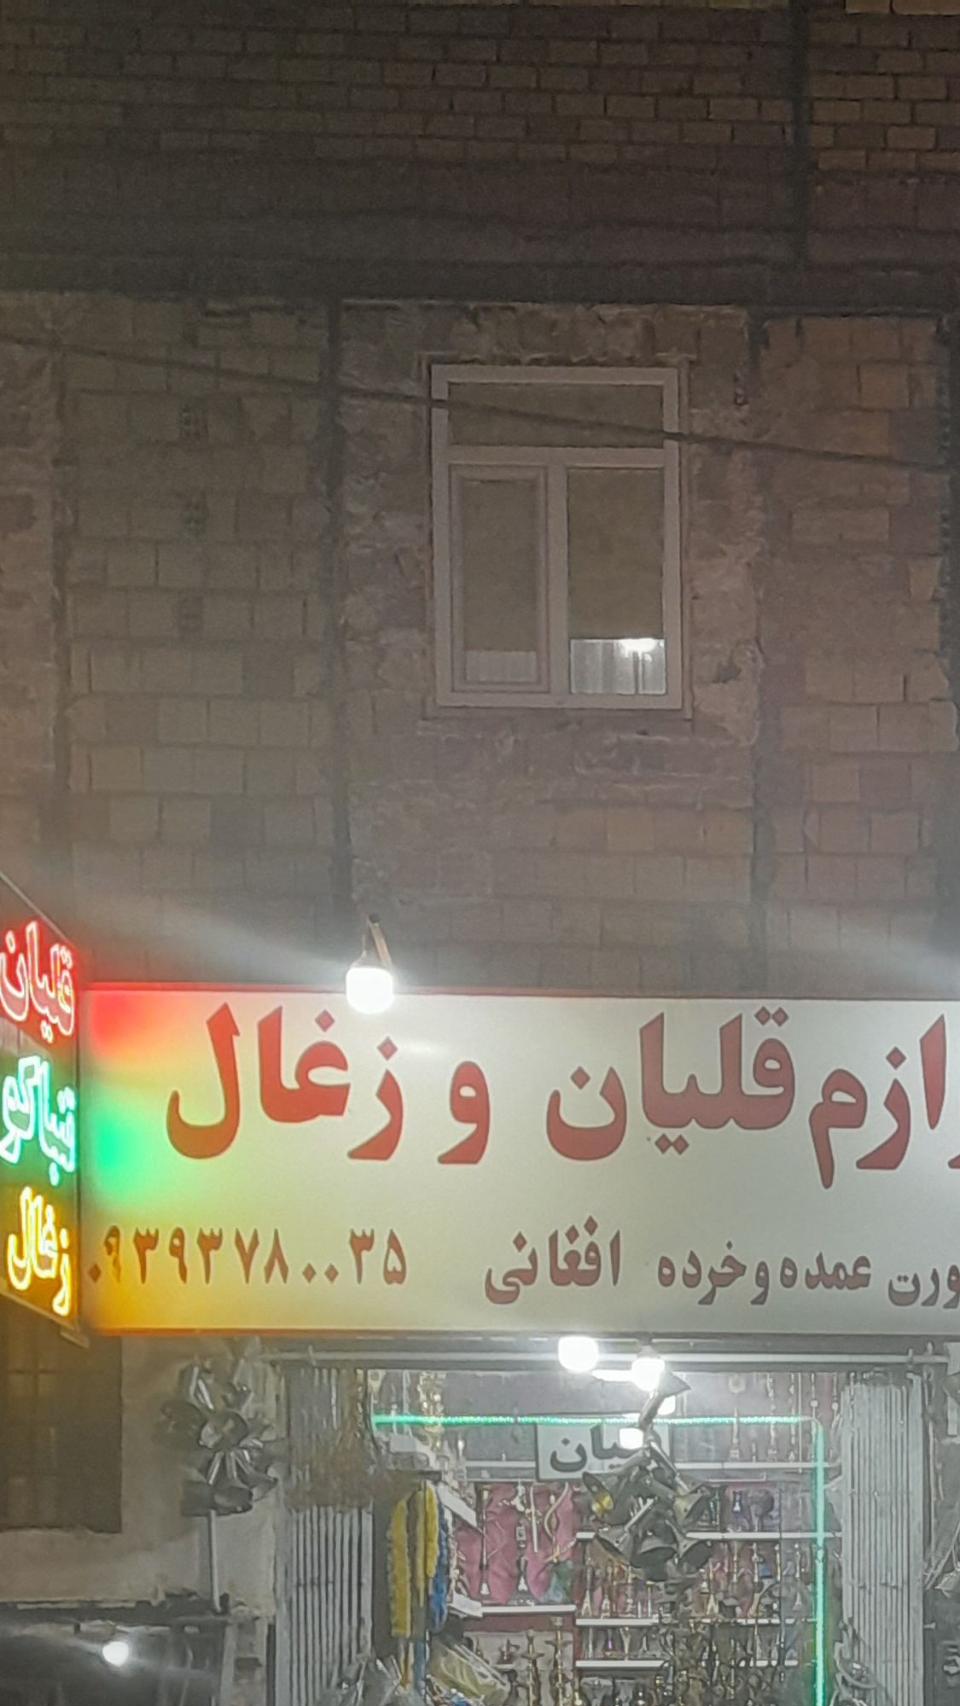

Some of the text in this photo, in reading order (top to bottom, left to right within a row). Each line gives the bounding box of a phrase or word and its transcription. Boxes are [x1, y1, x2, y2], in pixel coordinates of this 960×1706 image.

[0, 921, 76, 1043] قلیان
[166, 1003, 404, 1163] زغال
[437, 1060, 491, 1165] و
[546, 1006, 796, 1162] قلیان
[7, 1186, 72, 1317] زغال
[484, 1215, 622, 1305] افغانی
[657, 1240, 748, 1306] خرده
[750, 1260, 771, 1306] و
[779, 1252, 873, 1291] عمده
[550, 1423, 661, 1473] یان
